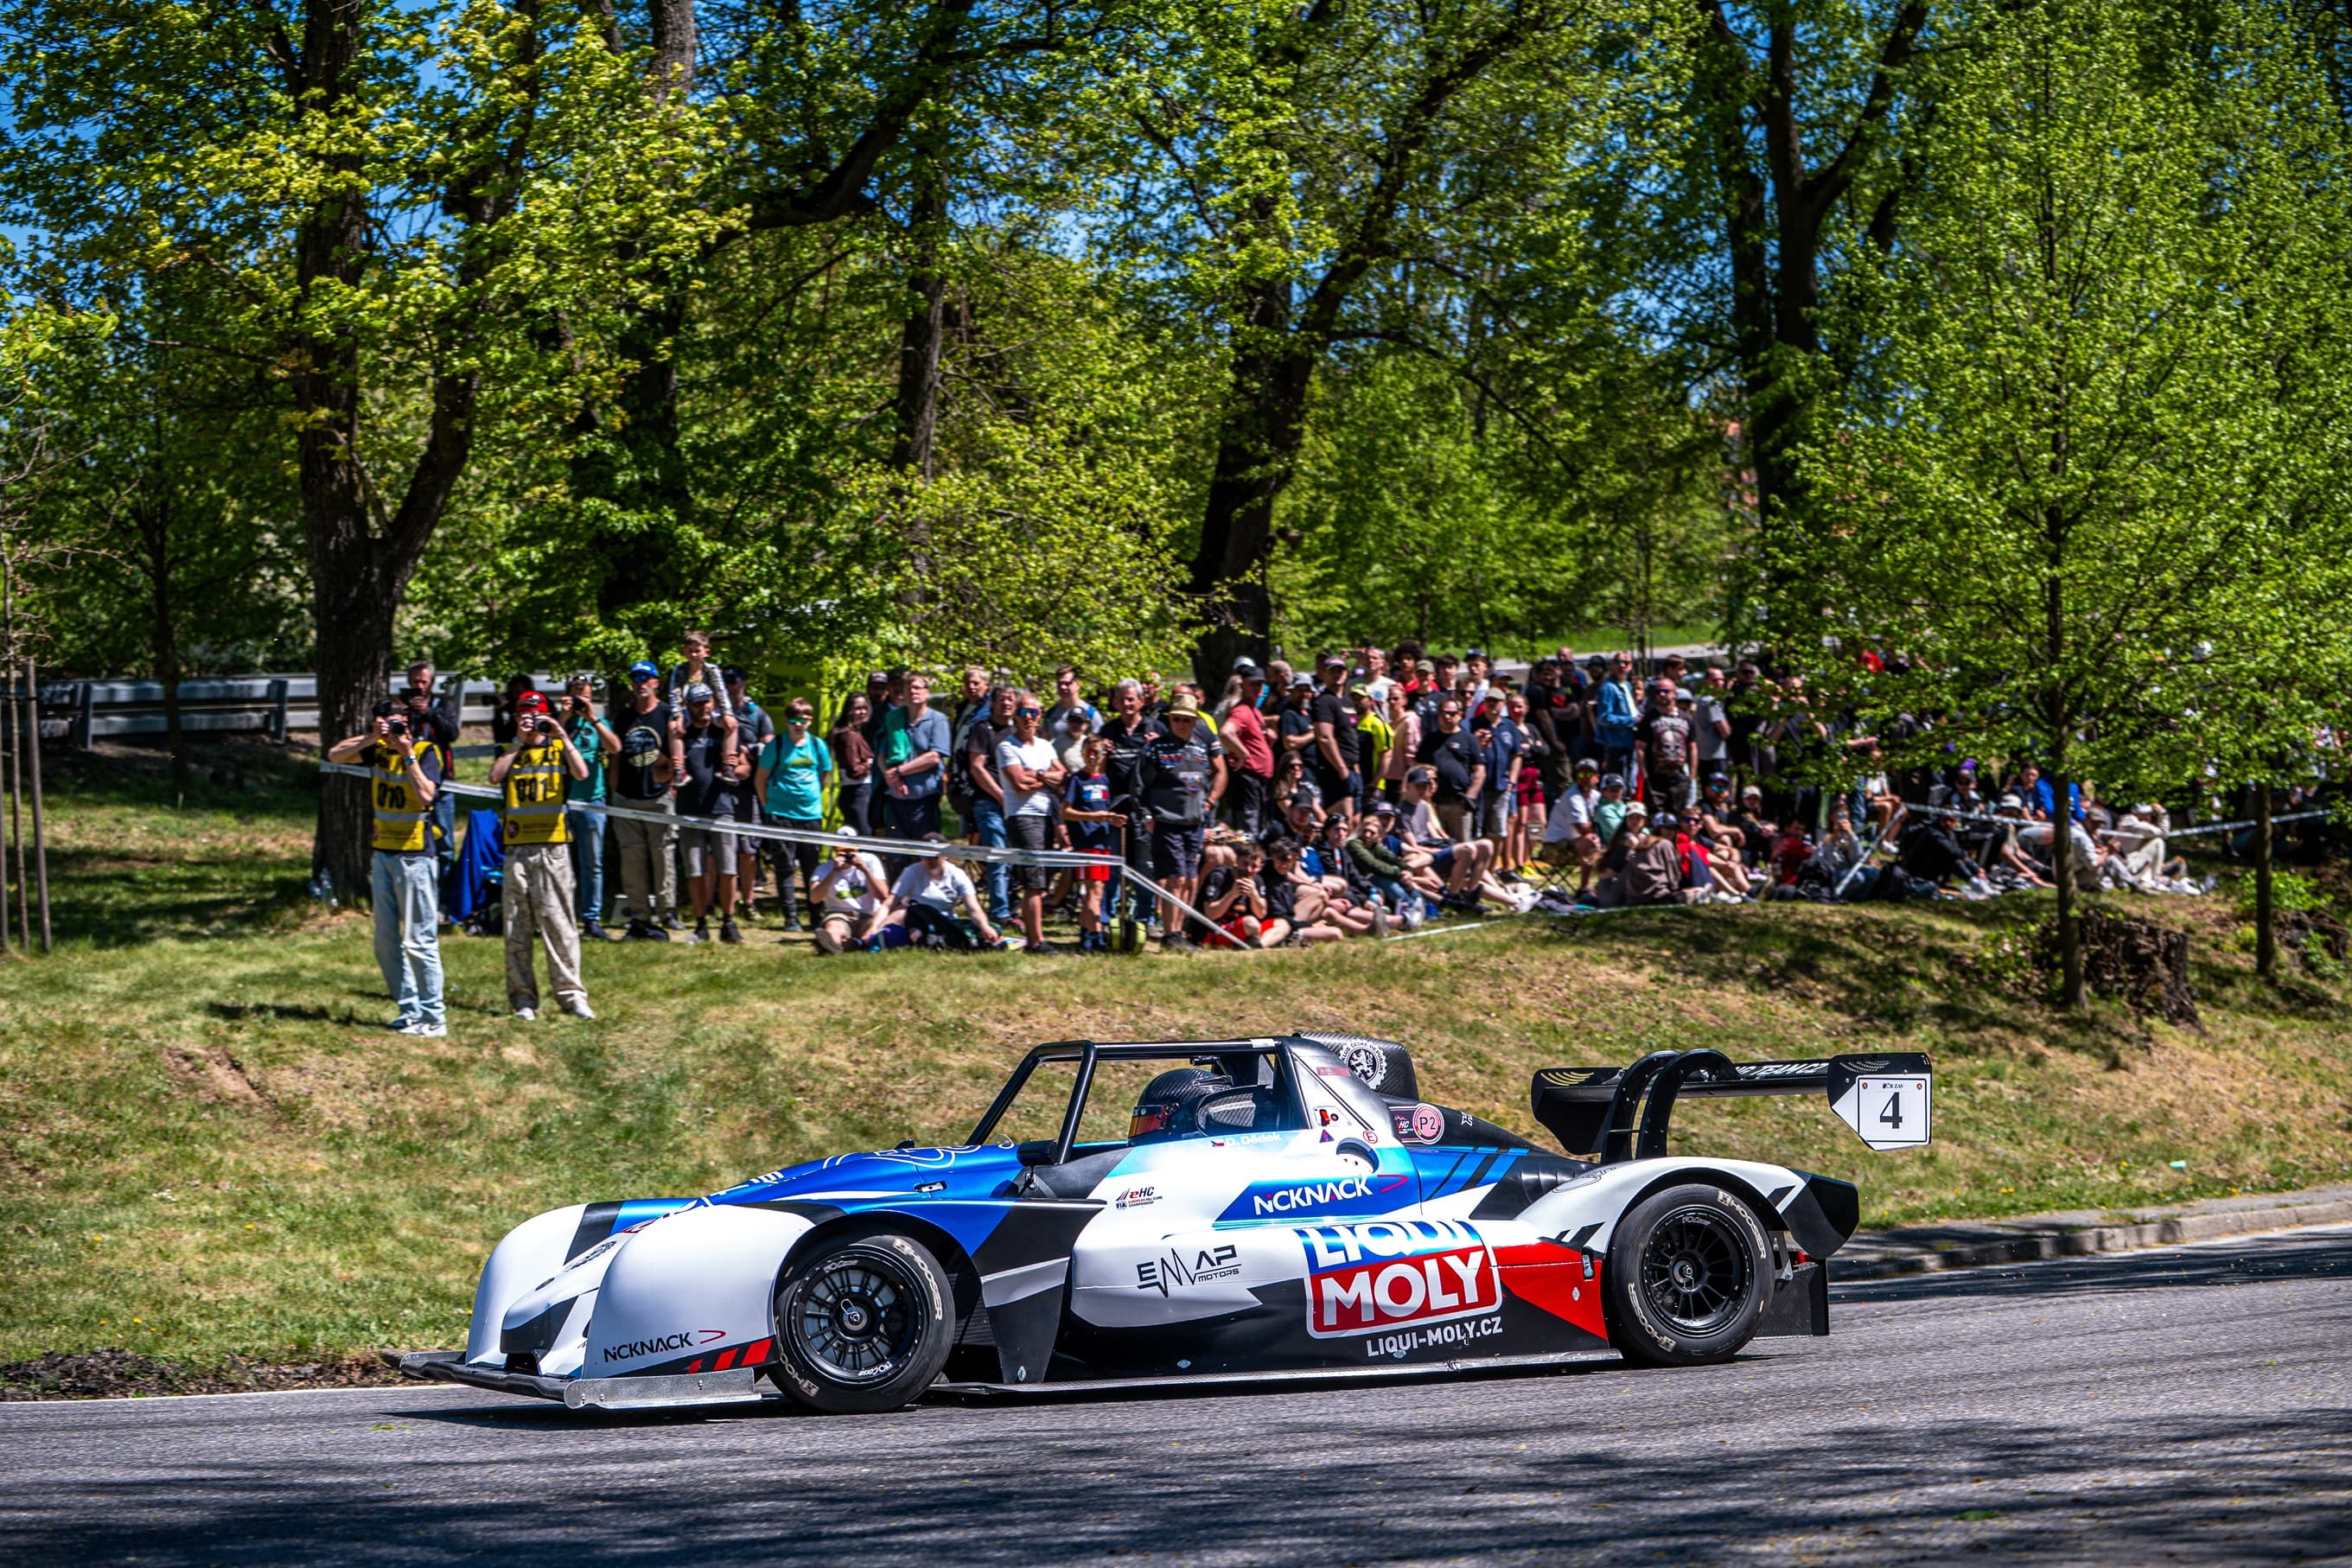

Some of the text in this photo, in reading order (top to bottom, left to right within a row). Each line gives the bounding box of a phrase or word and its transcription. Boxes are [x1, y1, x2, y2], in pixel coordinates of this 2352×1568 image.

[1419, 1116, 1436, 1130] P2
[1879, 1092, 1903, 1129] 4
[1366, 1131, 1375, 1143] E
[1129, 1187, 1155, 1199] eHC
[1303, 1221, 1481, 1268] LIQUI
[1198, 1268, 1240, 1283] MOTORS
[1321, 1250, 1485, 1326] MOLY
[1366, 1316, 1503, 1357] LIQUI-MOLY.CZ
